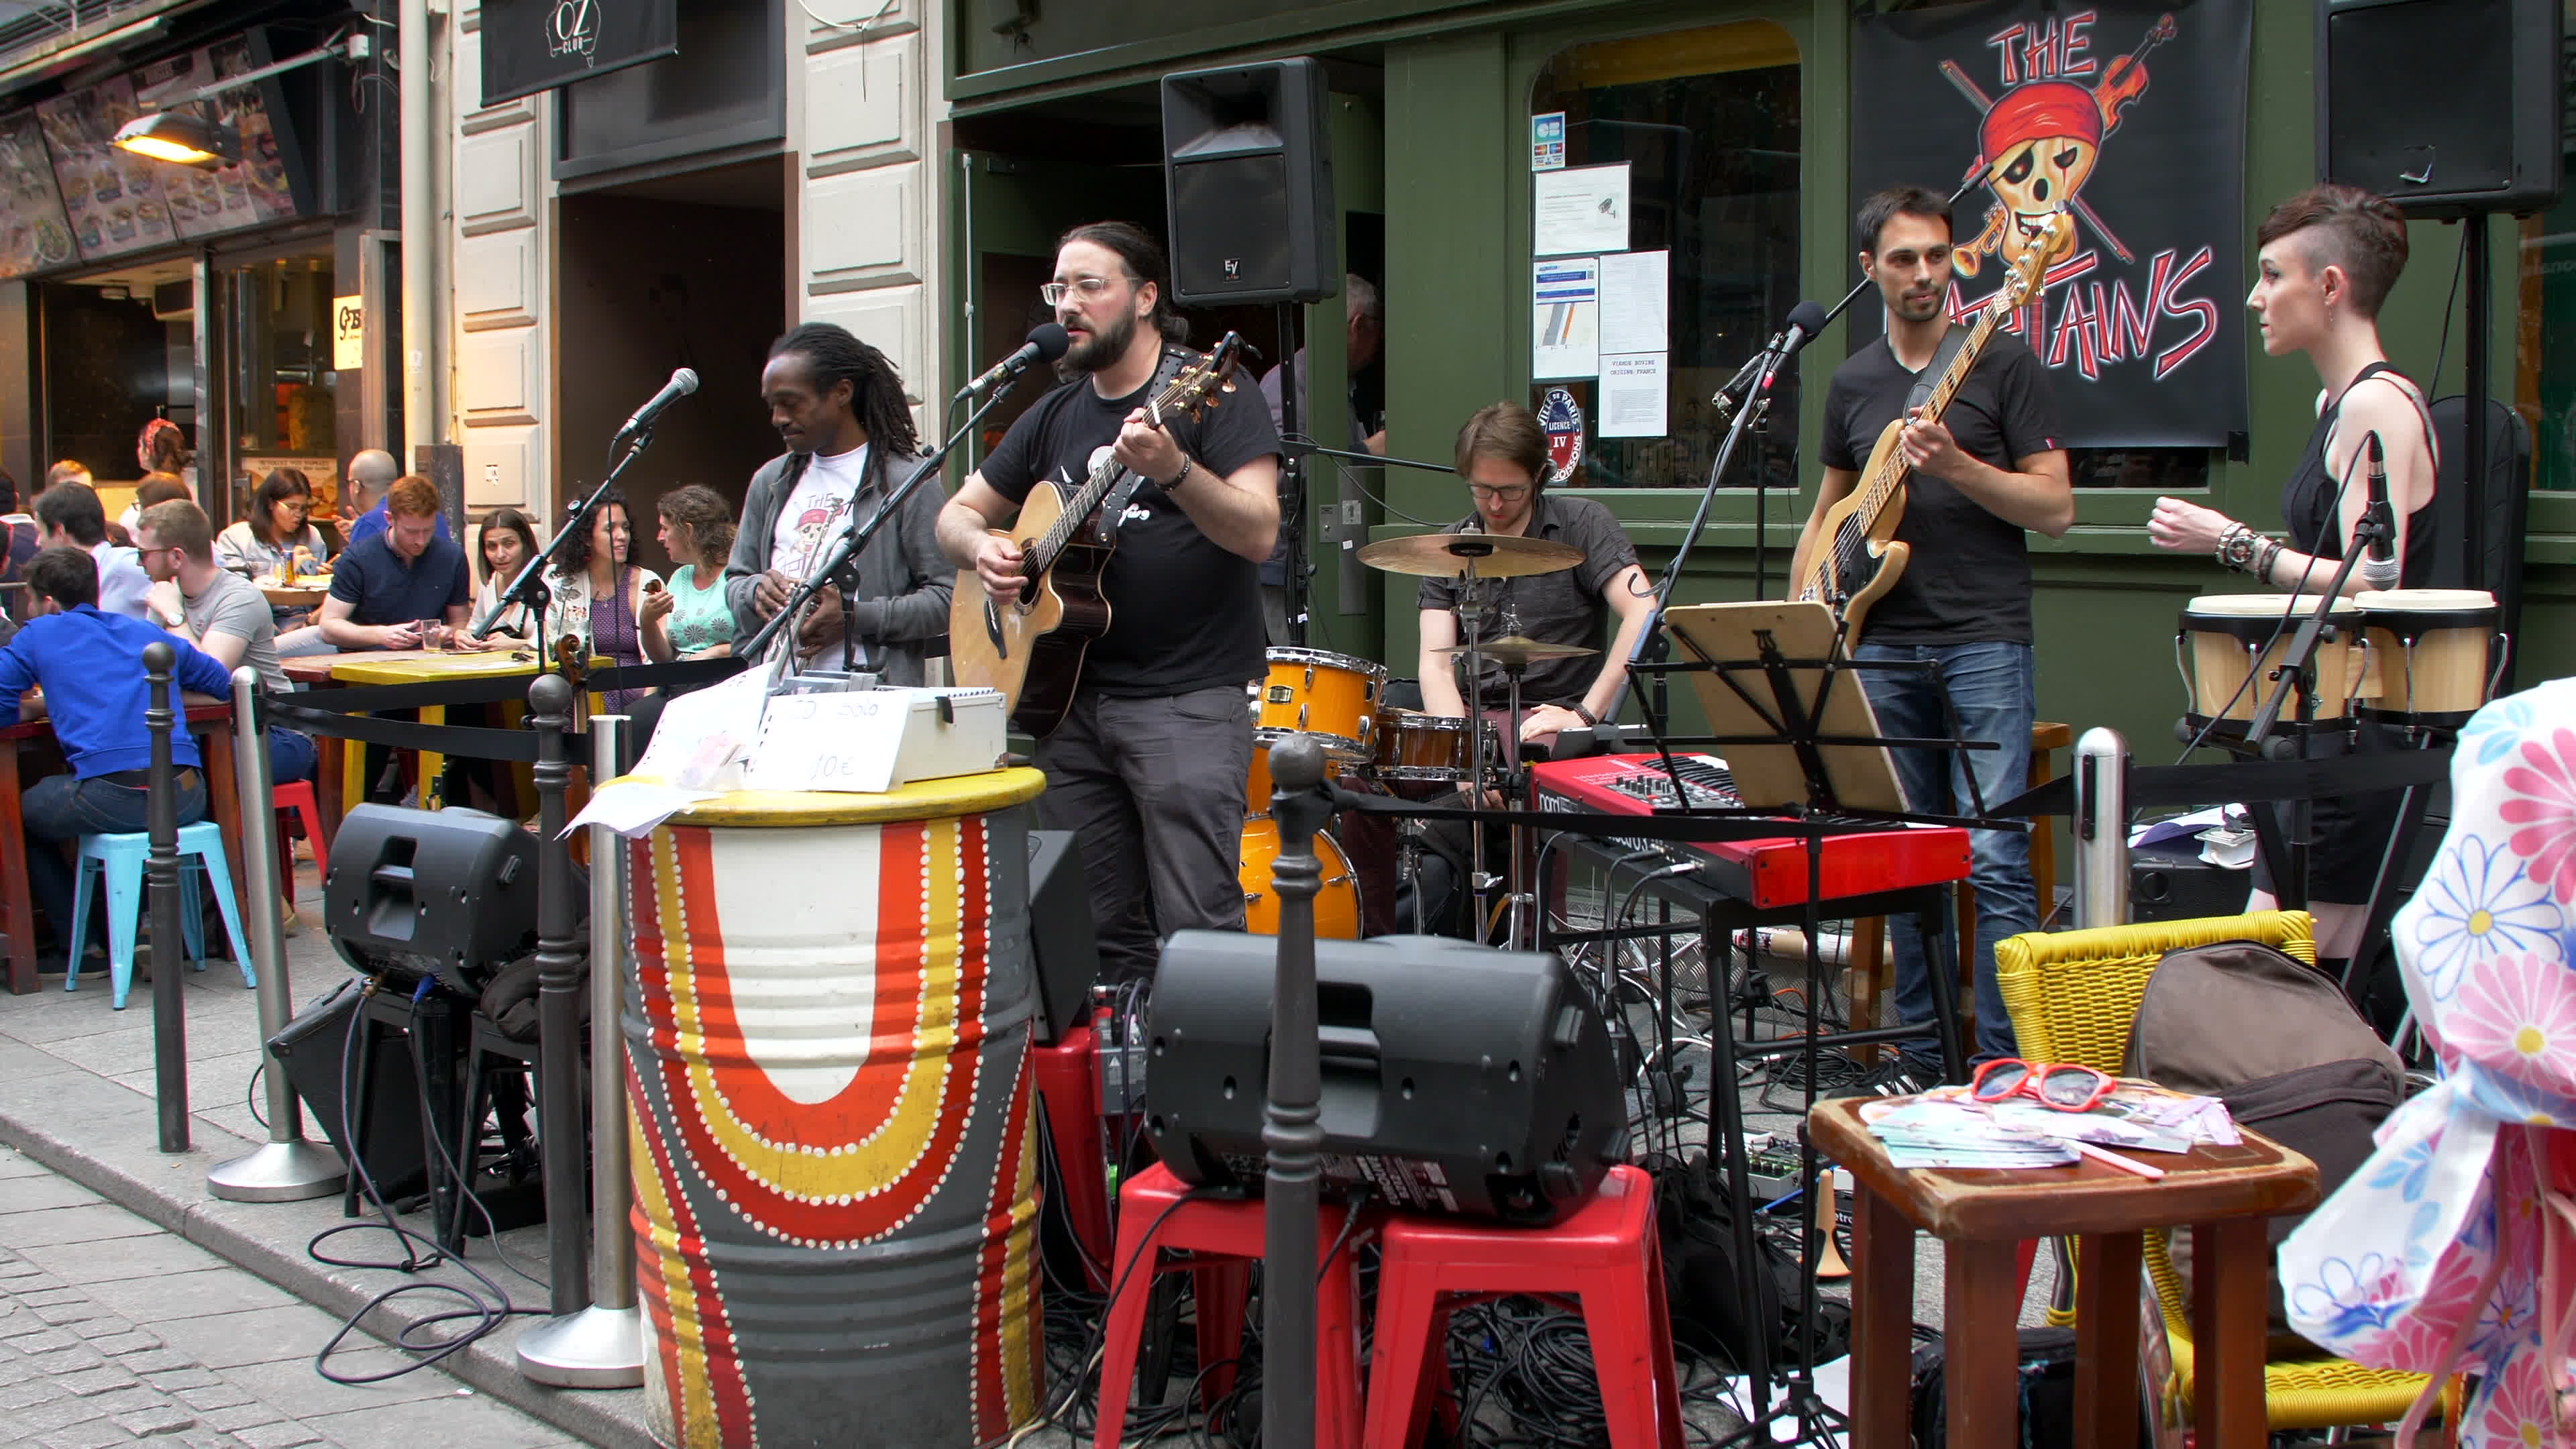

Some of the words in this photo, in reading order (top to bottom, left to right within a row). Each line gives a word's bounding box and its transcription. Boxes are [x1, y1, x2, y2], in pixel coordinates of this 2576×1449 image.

[555, 0, 590, 40] OZ
[563, 36, 584, 54] CLUB
[1985, 11, 2098, 86] THE
[1880, 246, 2220, 383] ATAINS
[1539, 397, 1554, 427] VILLE
[1562, 394, 1580, 425] PARIS
[1548, 421, 1571, 431] LICENCE
[1553, 436, 1567, 448] IV
[806, 492, 835, 508] THE
